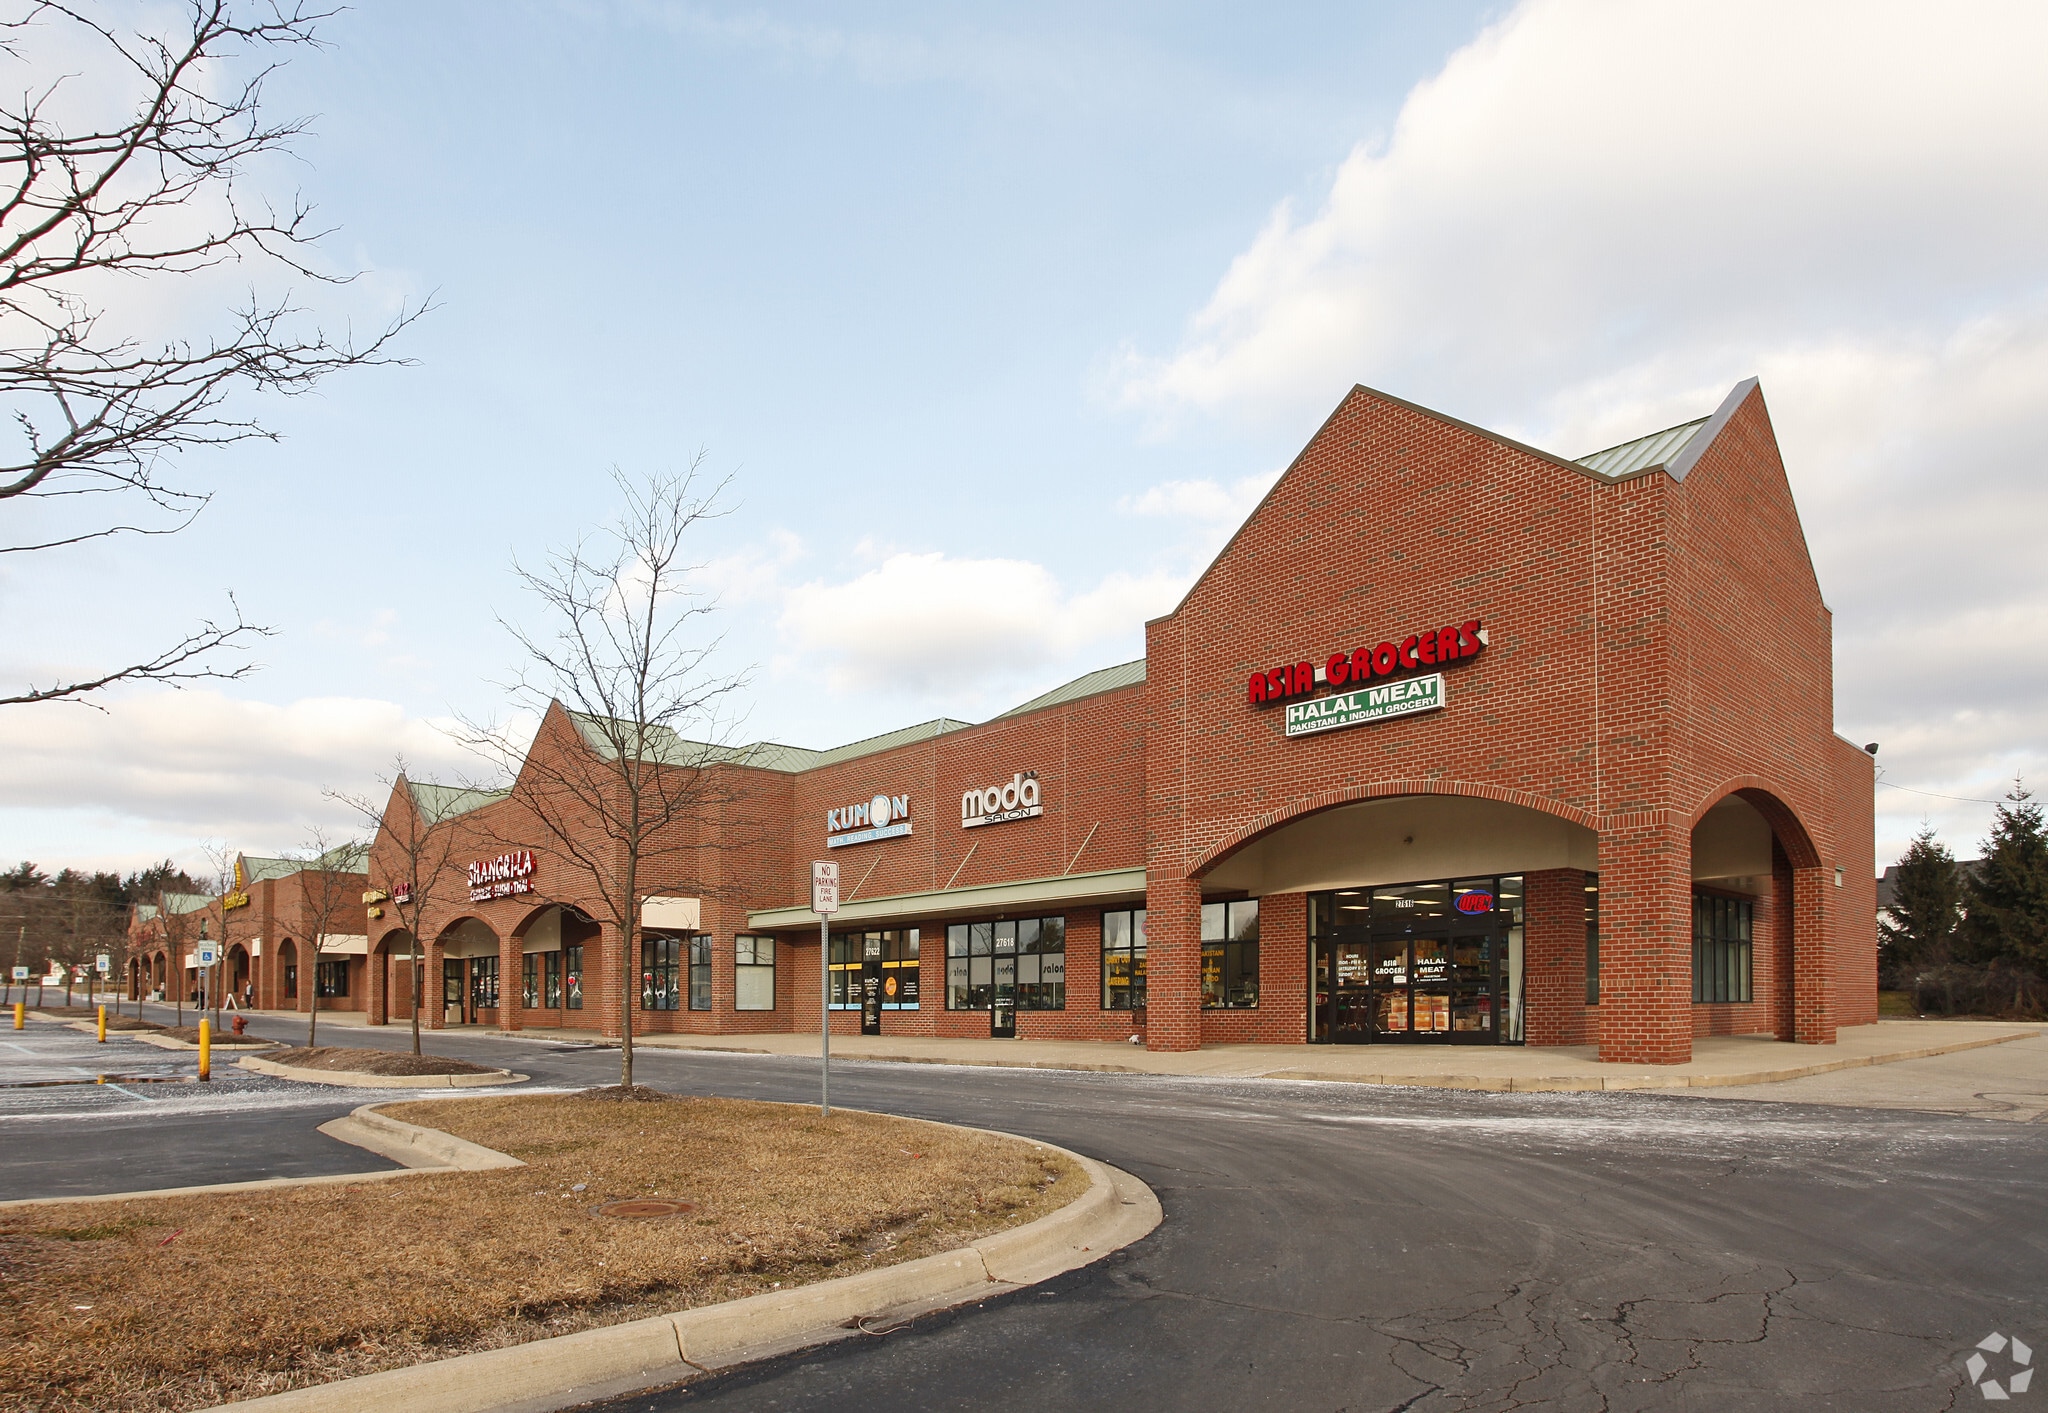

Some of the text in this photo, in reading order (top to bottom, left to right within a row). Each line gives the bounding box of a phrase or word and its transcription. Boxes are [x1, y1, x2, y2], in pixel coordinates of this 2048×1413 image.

[1249, 620, 1481, 704] ASIA GROCERS
[1289, 678, 1436, 723] HALAL MEAT
[1290, 696, 1436, 733] PAKISTANI & INDIAN GROCERY
[828, 794, 908, 832] KUMON
[984, 808, 1031, 823] SALON
[468, 850, 532, 887] SHANGRI-LA
[822, 866, 831, 876] NO
[815, 877, 837, 888] PARKING
[865, 947, 880, 956] 27622
[1043, 963, 1064, 974] salon
